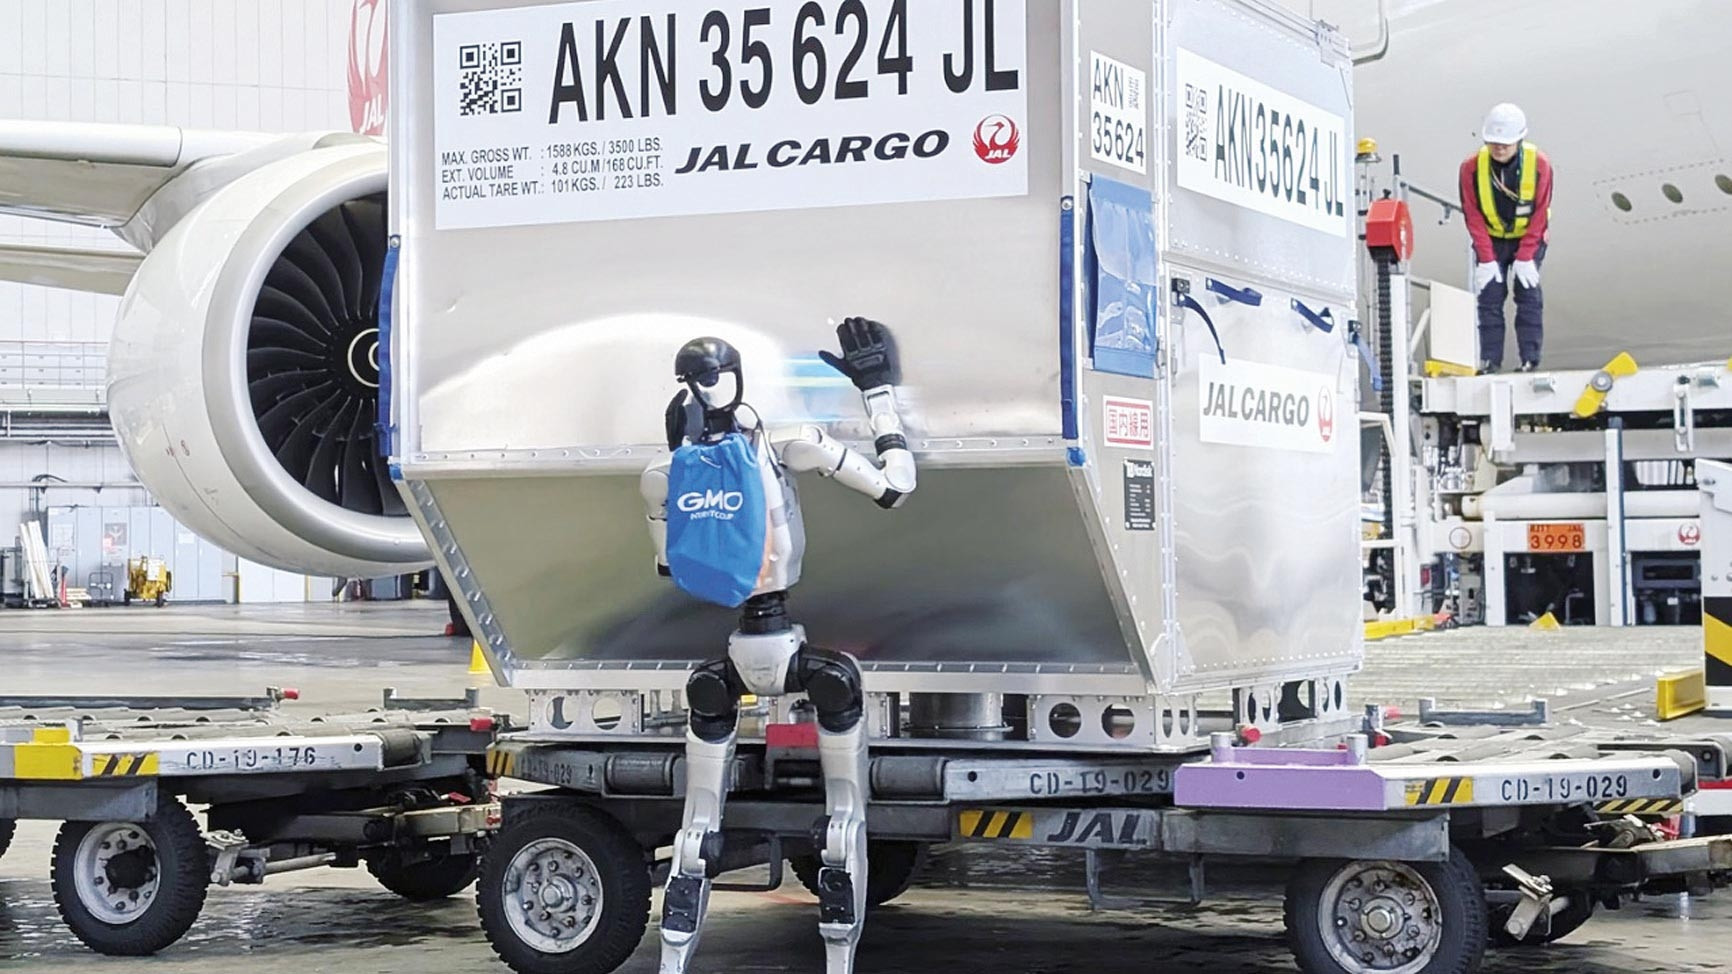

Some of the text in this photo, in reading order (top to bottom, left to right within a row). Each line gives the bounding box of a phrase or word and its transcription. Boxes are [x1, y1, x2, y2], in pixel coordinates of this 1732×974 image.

[548, 14, 676, 124] AKN
[942, 0, 1018, 92] JL
[1093, 58, 1124, 110] AKN
[442, 151, 468, 166] MAX.
[471, 148, 509, 163] GROSS
[512, 146, 532, 161] WT.
[638, 137, 663, 152] LBS.
[675, 130, 950, 174] JAL CARGO
[1093, 111, 1144, 167] 35624
[442, 169, 465, 183] EXT.
[468, 165, 514, 181] VOLUME
[552, 161, 568, 175] 4.8
[443, 182, 486, 200] ACTUAL
[489, 181, 518, 197] TARE
[614, 175, 633, 190] 223
[637, 172, 663, 188] LBS.
[1108, 408, 1149, 438] 国内線用
[677, 489, 743, 511] GMO
[1531, 534, 1582, 549] 3998
[187, 746, 316, 769] CD-19-176
[1030, 768, 1169, 795] CD-19-029
[1501, 775, 1628, 800] CD-19-029
[1047, 812, 1149, 845] JAL
